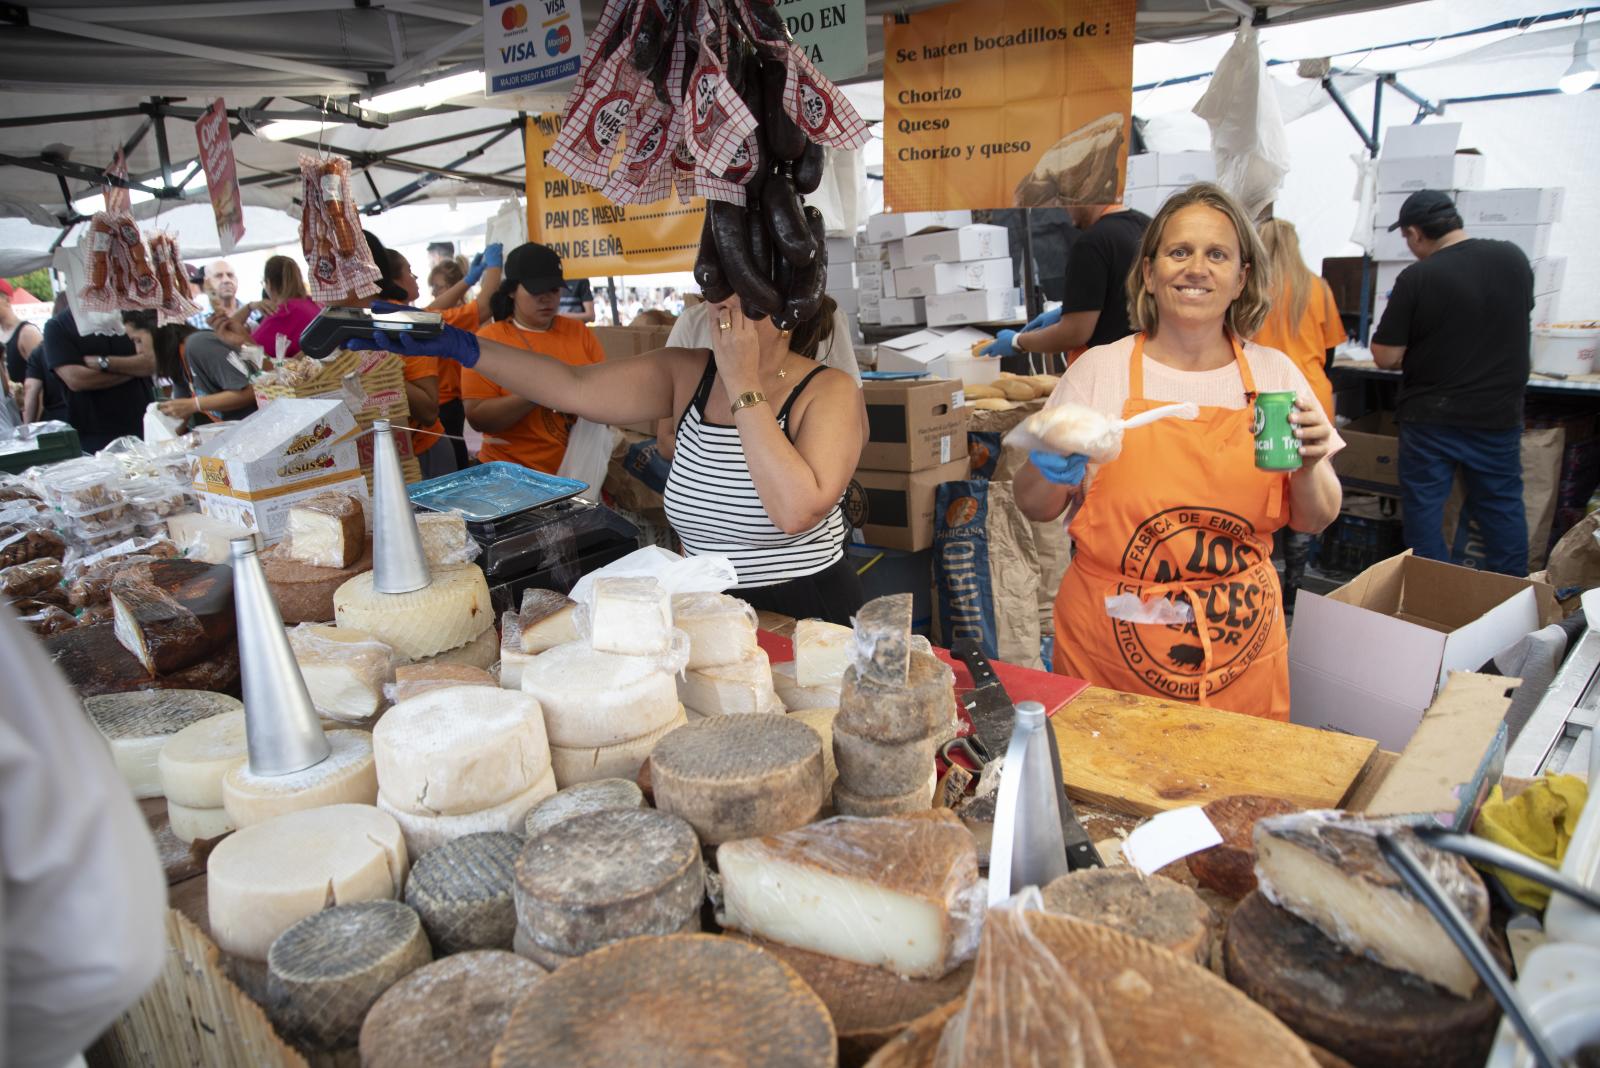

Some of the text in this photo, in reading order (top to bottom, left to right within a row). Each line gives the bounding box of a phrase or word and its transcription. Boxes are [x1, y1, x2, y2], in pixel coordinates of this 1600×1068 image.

[544, 0, 566, 15] VISA
[820, 4, 846, 29] EN
[499, 40, 537, 64] VISA
[547, 35, 570, 48] Maestro
[896, 48, 917, 63] Se
[922, 39, 968, 60] hacen
[974, 25, 1067, 52] bocadillos
[1073, 20, 1098, 38] de
[500, 75, 519, 86] MAJOR
[520, 71, 539, 81] CREDIT
[545, 67, 559, 77] DEBIT
[559, 62, 575, 73] CARDS
[898, 85, 962, 105] Chorizo
[898, 116, 950, 134] Queso
[898, 140, 1031, 163] Chorizo y queso
[545, 180, 568, 199] PAN
[545, 205, 626, 229] PAN DE HUEVO
[573, 242, 589, 258] DE
[593, 233, 624, 257] LEÑA
[1282, 436, 1302, 449] Tro
[281, 459, 317, 477] Jesus
[1179, 512, 1200, 524] DE
[1186, 530, 1252, 576] LOS
[943, 541, 984, 642] DIARIO
[1118, 619, 1269, 695] NTICO CHORIZO DE TEROR
